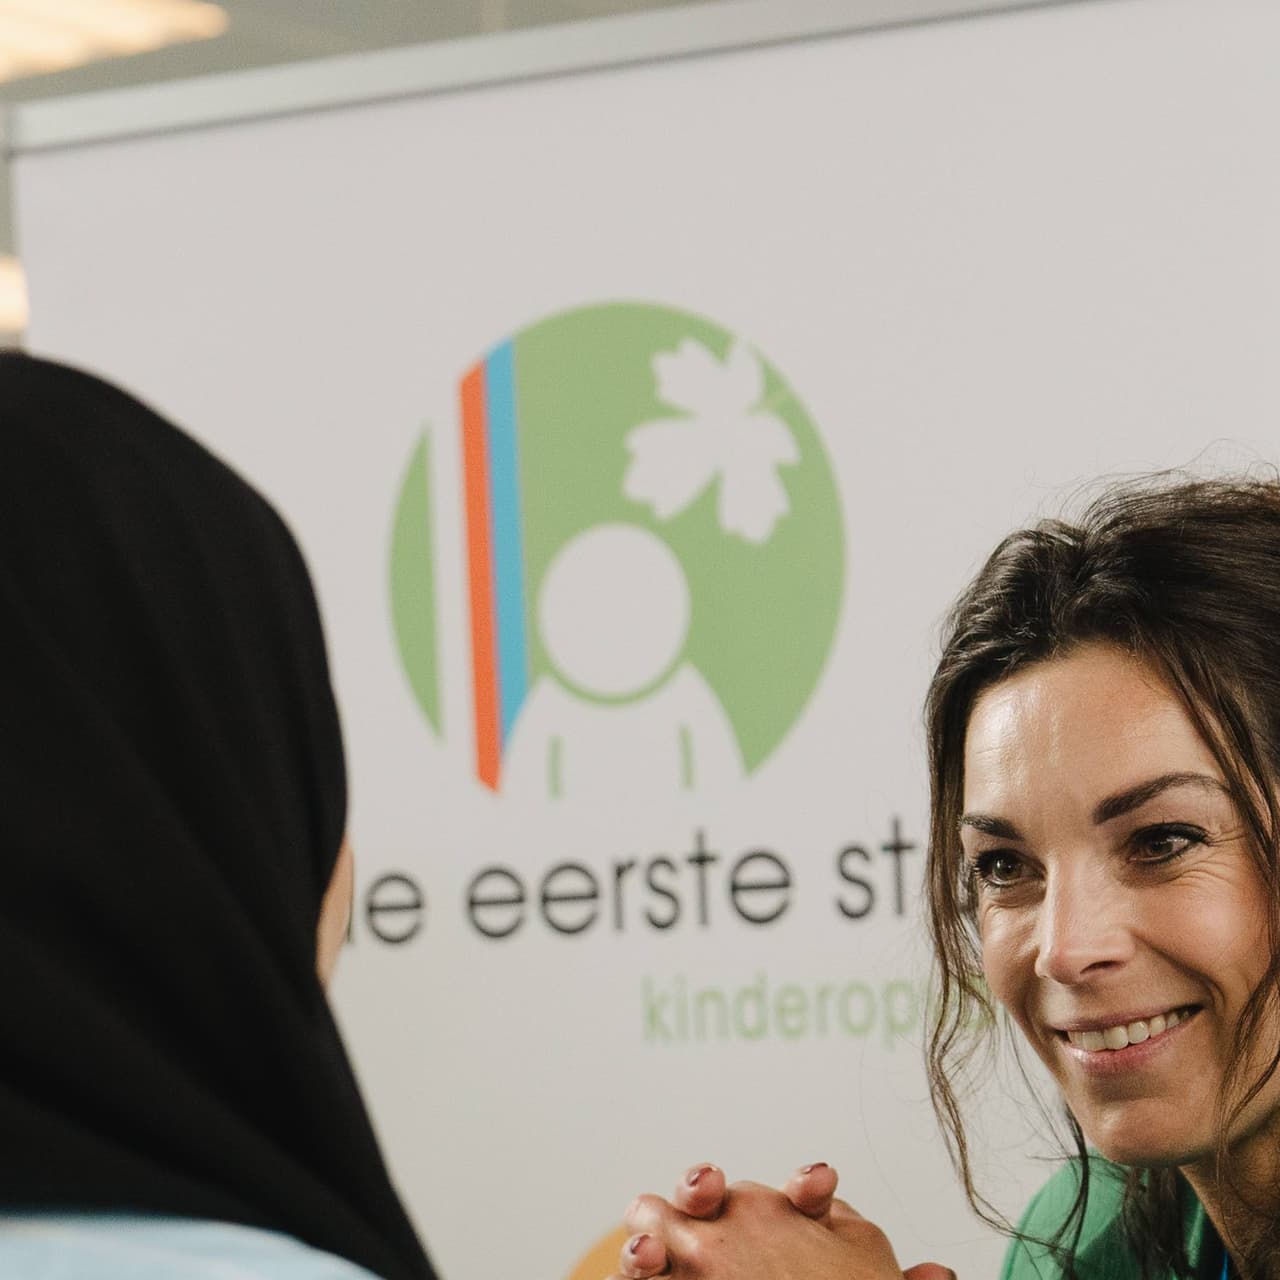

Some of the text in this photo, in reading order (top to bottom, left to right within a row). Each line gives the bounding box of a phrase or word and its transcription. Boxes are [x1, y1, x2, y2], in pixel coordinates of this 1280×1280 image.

[347, 817, 918, 949] e eerste st
